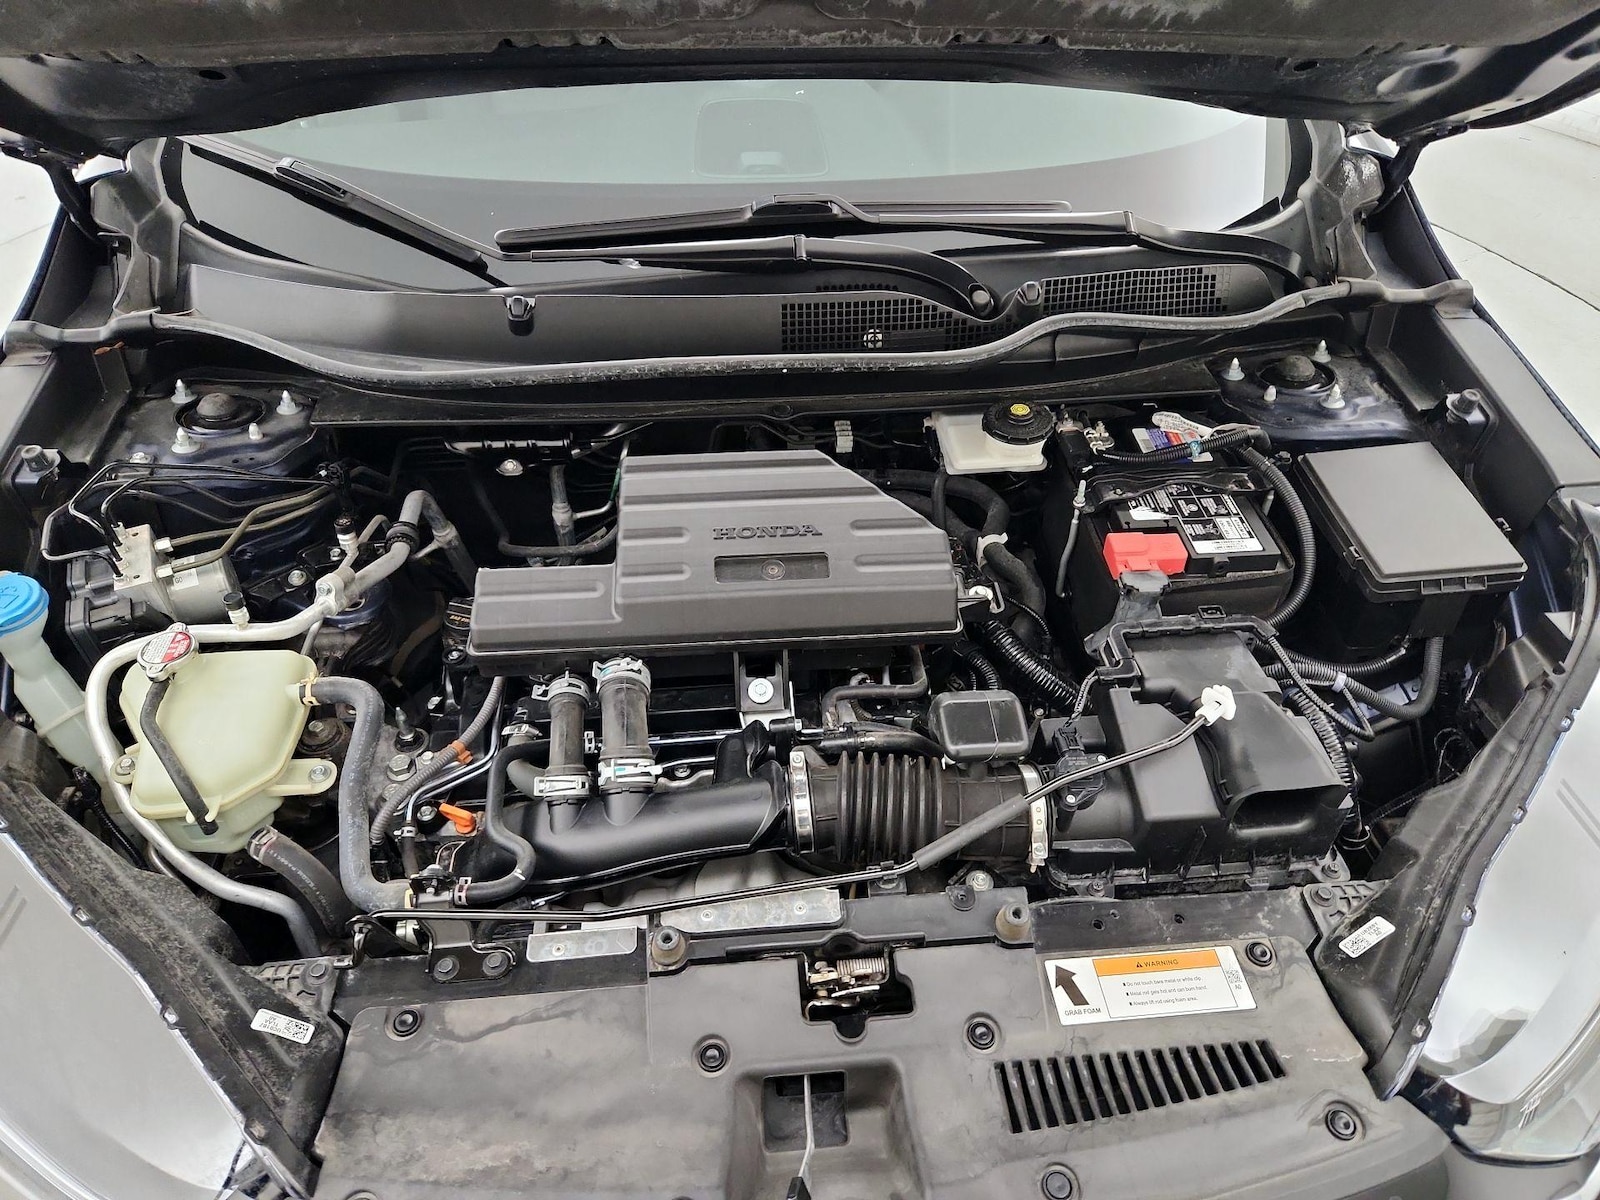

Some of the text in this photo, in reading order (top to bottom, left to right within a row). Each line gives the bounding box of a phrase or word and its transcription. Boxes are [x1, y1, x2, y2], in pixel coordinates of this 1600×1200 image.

[712, 524, 823, 540] HONDA
[1144, 958, 1179, 967] WARNING
[1064, 1008, 1082, 1016] GRAB
